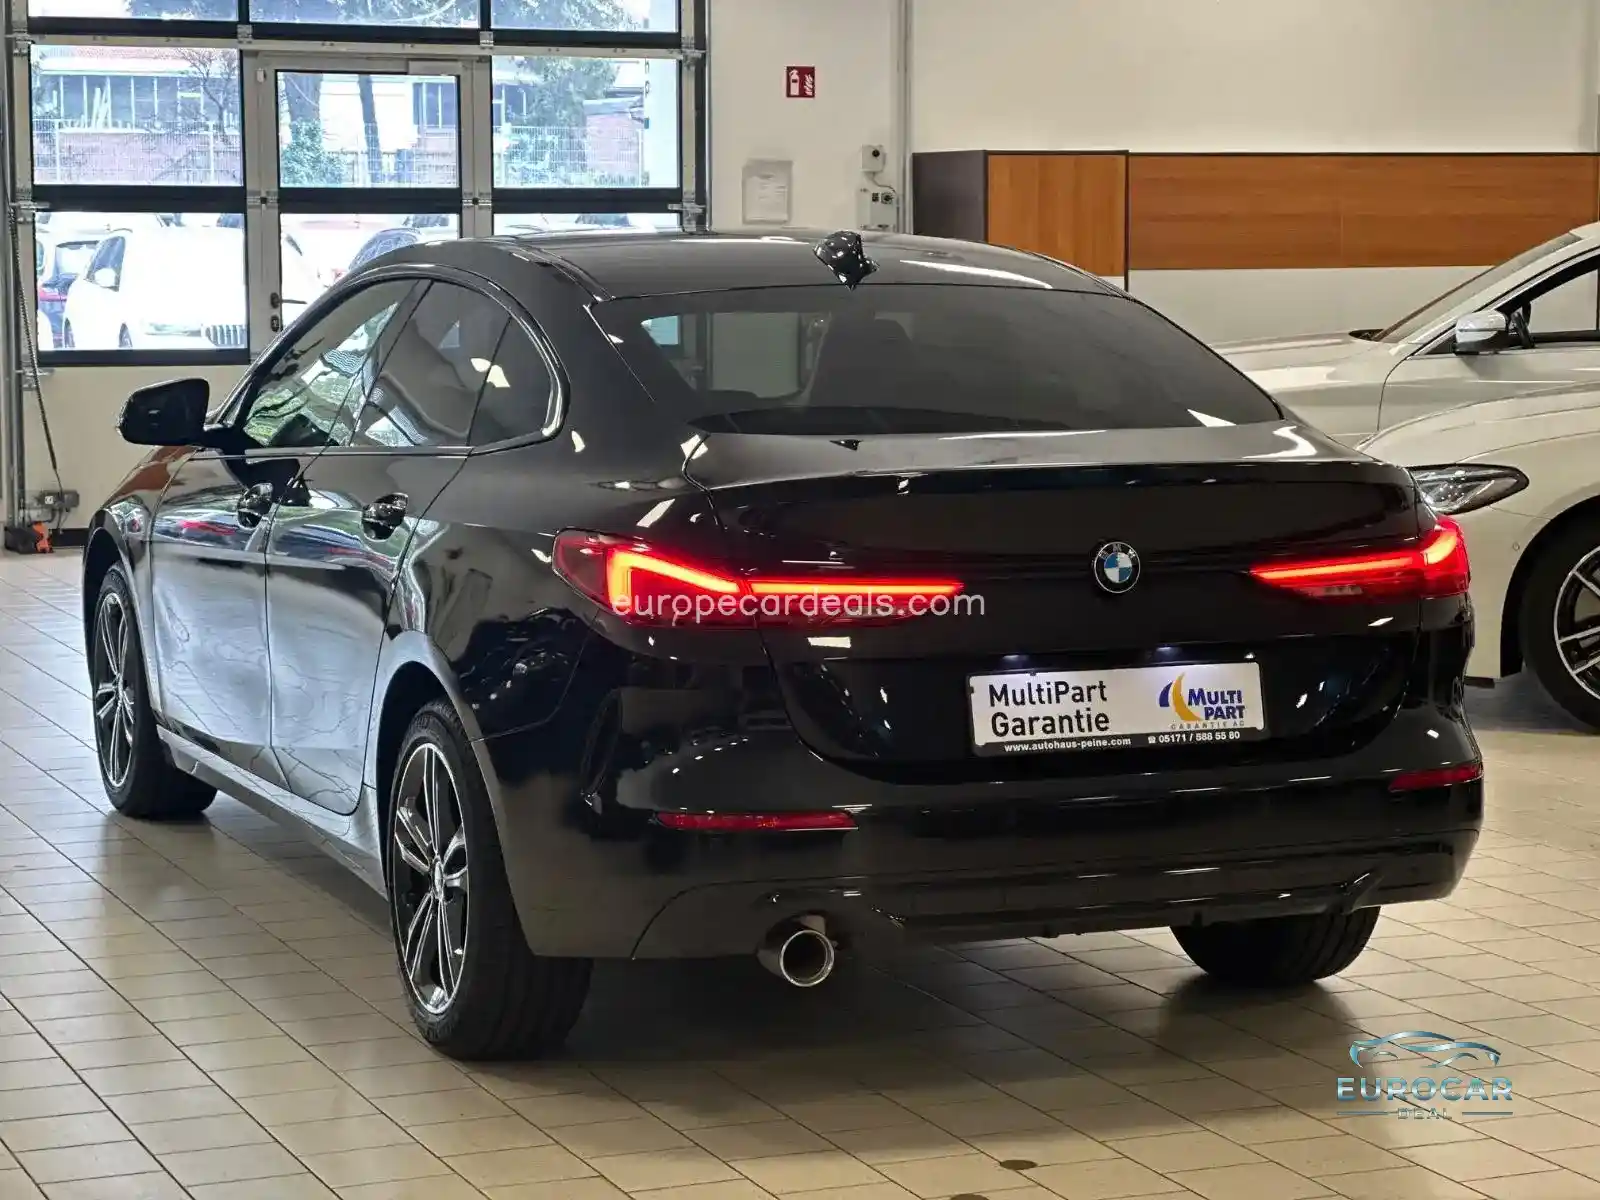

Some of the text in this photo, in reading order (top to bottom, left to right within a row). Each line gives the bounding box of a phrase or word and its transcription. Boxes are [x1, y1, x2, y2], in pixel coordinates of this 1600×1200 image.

[988, 680, 1108, 707] MultiPart
[1187, 688, 1243, 706] MULTI
[1204, 705, 1245, 720] PART
[991, 707, 1110, 737] Garantie
[1170, 721, 1228, 730] GARANTIE
[1158, 733, 1187, 743] 05171
[1215, 731, 1226, 740] 55
[1229, 730, 1240, 739] 80
[1004, 737, 1132, 752] www.autohaus-peine.com
